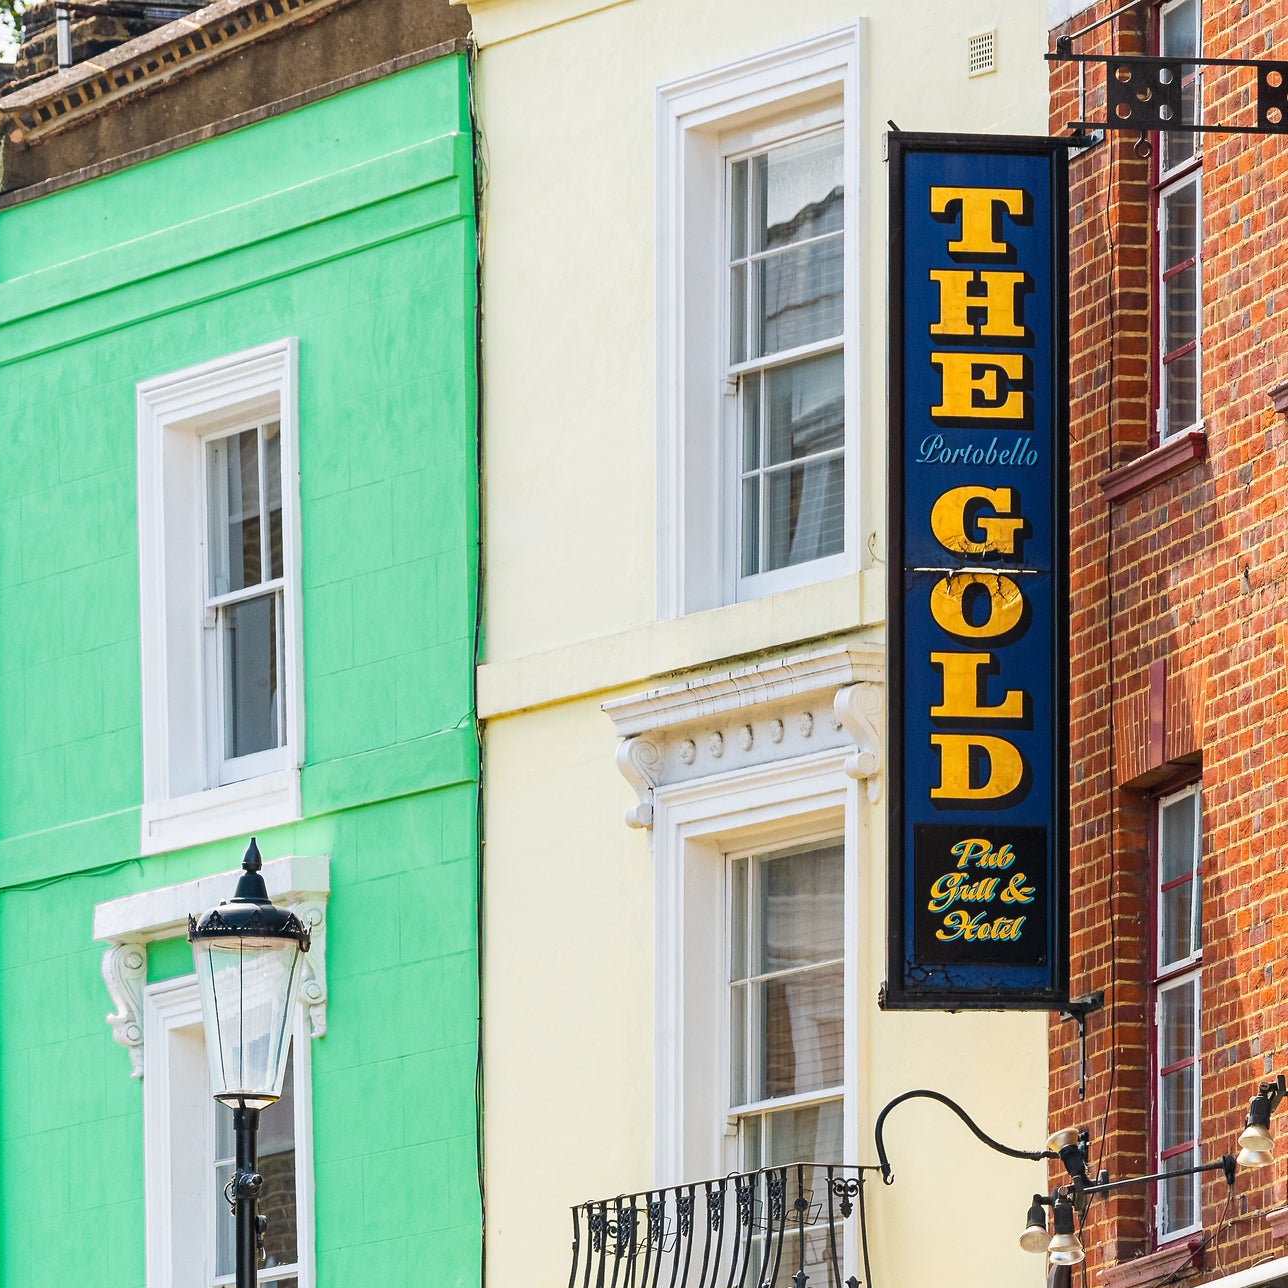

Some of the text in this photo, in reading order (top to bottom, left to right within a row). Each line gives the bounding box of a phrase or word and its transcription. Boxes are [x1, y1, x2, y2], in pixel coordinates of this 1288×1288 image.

[929, 186, 1024, 418] THE
[916, 434, 1040, 467] Portobello
[930, 485, 1024, 799] GOLD
[950, 838, 1015, 871] Pub
[929, 873, 1036, 914] Grill &
[935, 910, 1026, 944] Hotel
